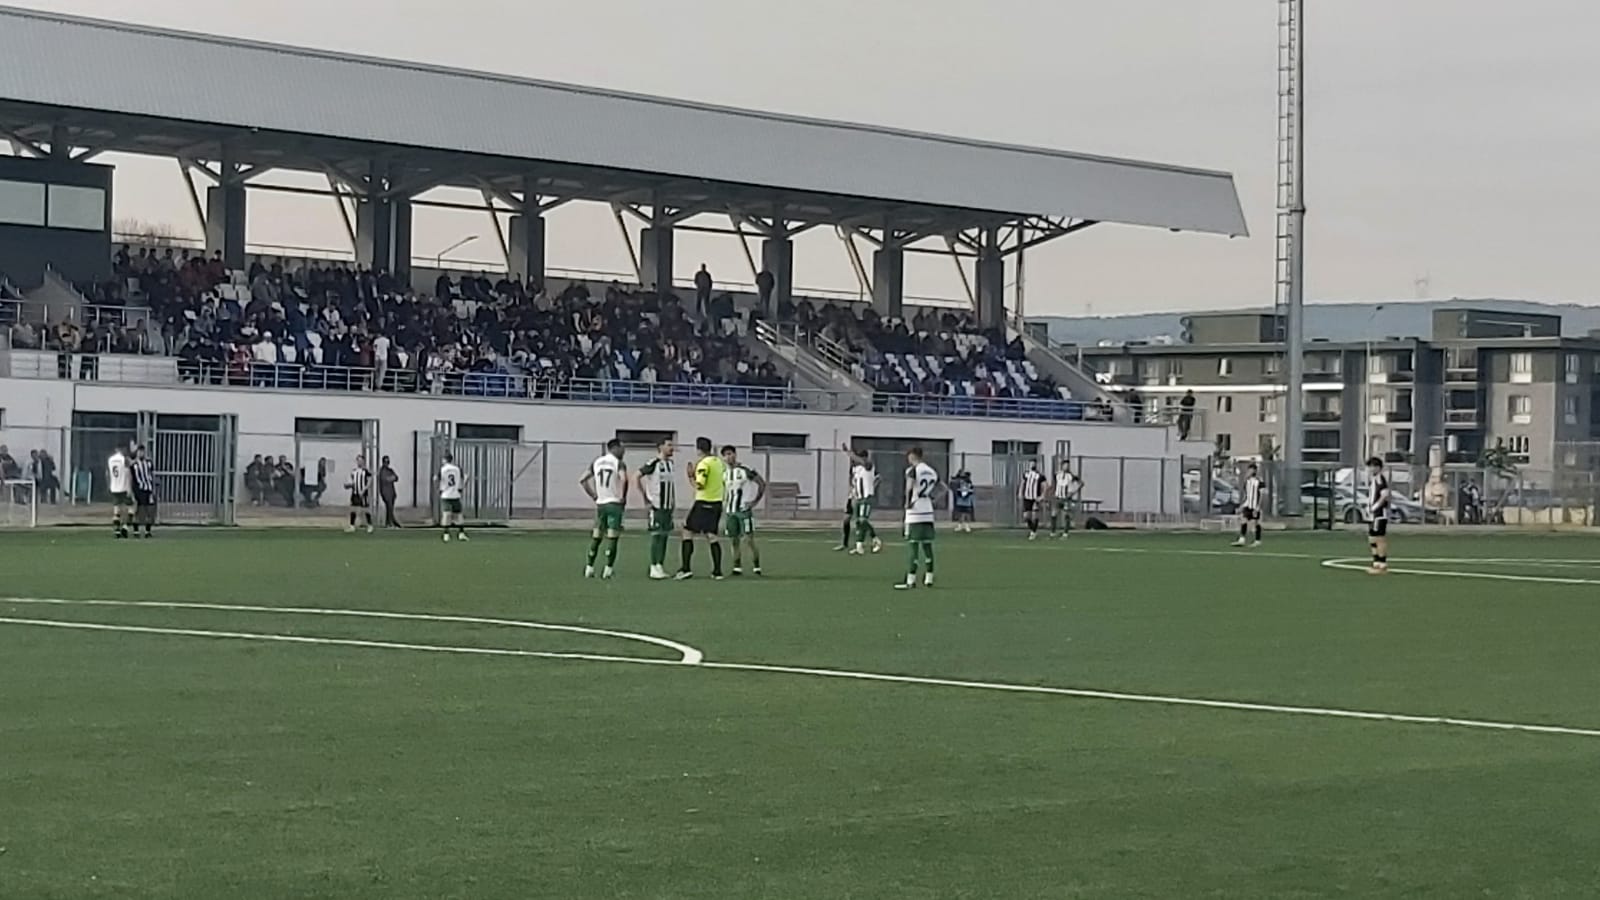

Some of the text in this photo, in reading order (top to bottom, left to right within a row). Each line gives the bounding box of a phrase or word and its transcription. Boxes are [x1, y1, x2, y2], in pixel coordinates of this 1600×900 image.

[112, 465, 119, 478] 6
[597, 469, 613, 488] 17
[447, 473, 456, 487] 3
